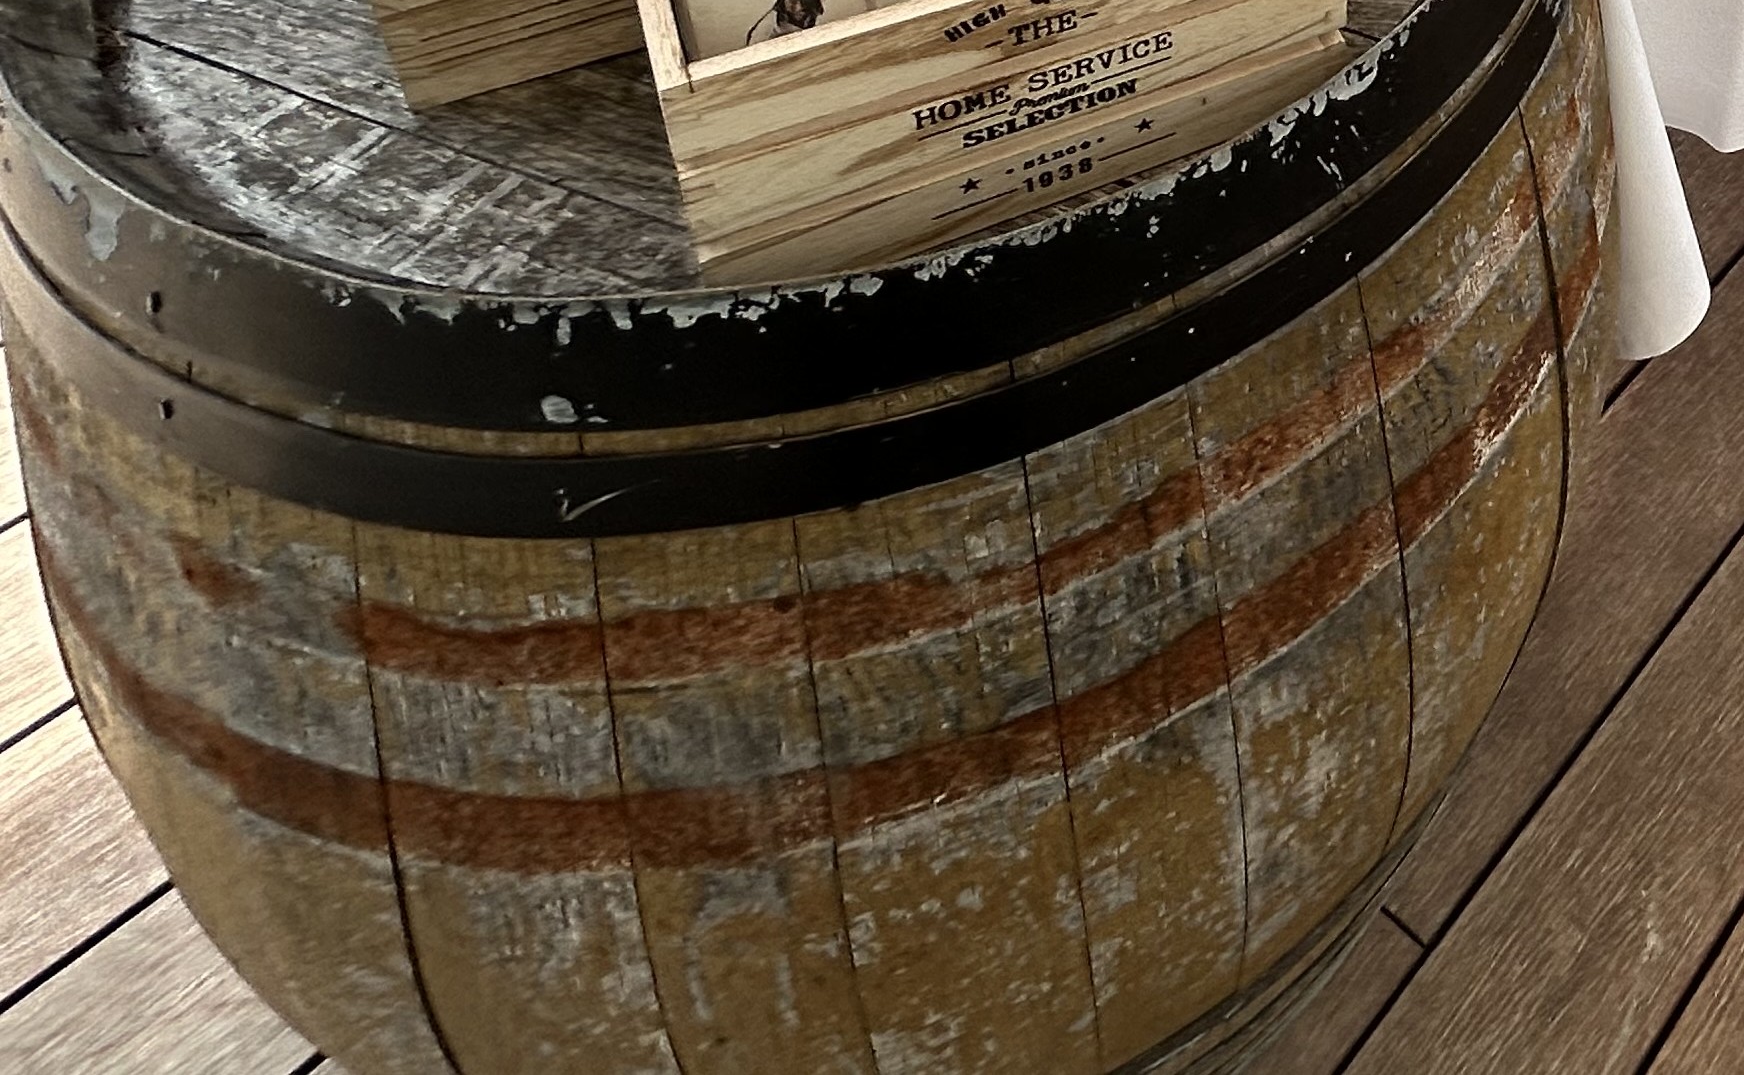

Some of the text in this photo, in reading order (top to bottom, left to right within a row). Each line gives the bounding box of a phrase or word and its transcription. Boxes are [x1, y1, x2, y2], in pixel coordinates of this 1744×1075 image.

[944, 3, 1007, 42] HIGH
[1008, 10, 1078, 47] THE
[912, 32, 1174, 130] HOME SERVICE
[962, 78, 1139, 149] SELECTION
[1022, 157, 1094, 193] 1938
